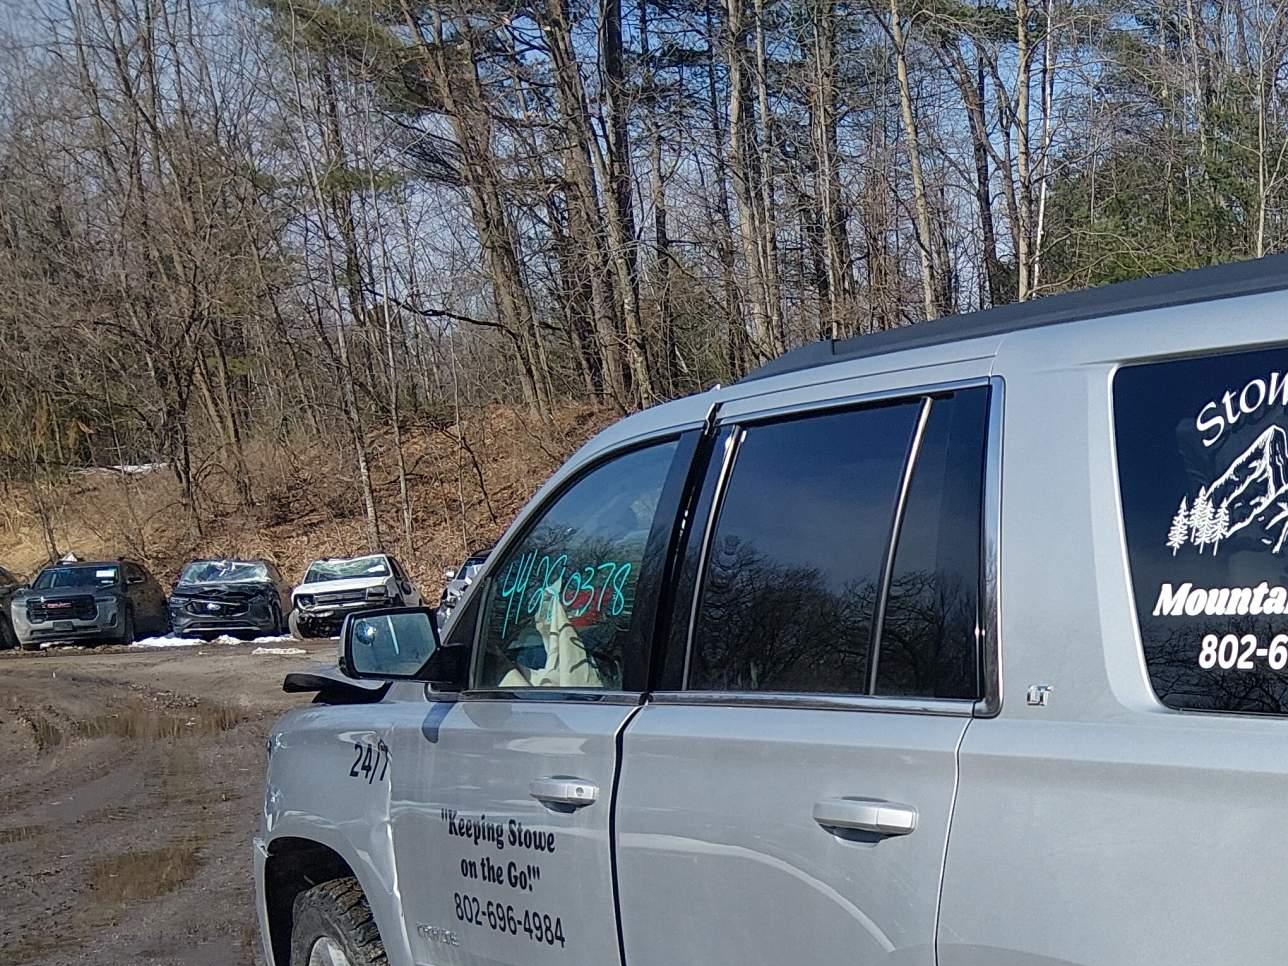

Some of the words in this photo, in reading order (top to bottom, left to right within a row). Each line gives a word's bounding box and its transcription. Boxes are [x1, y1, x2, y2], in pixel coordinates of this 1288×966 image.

[1026, 684, 1053, 707] LT
[350, 738, 391, 785] 24/7
[441, 808, 504, 850] "Keeping
[508, 818, 556, 853] Stowe
[460, 858, 478, 879] on
[481, 856, 504, 885] the
[507, 861, 540, 892] Go!"
[454, 892, 566, 949] 802-696-4984
